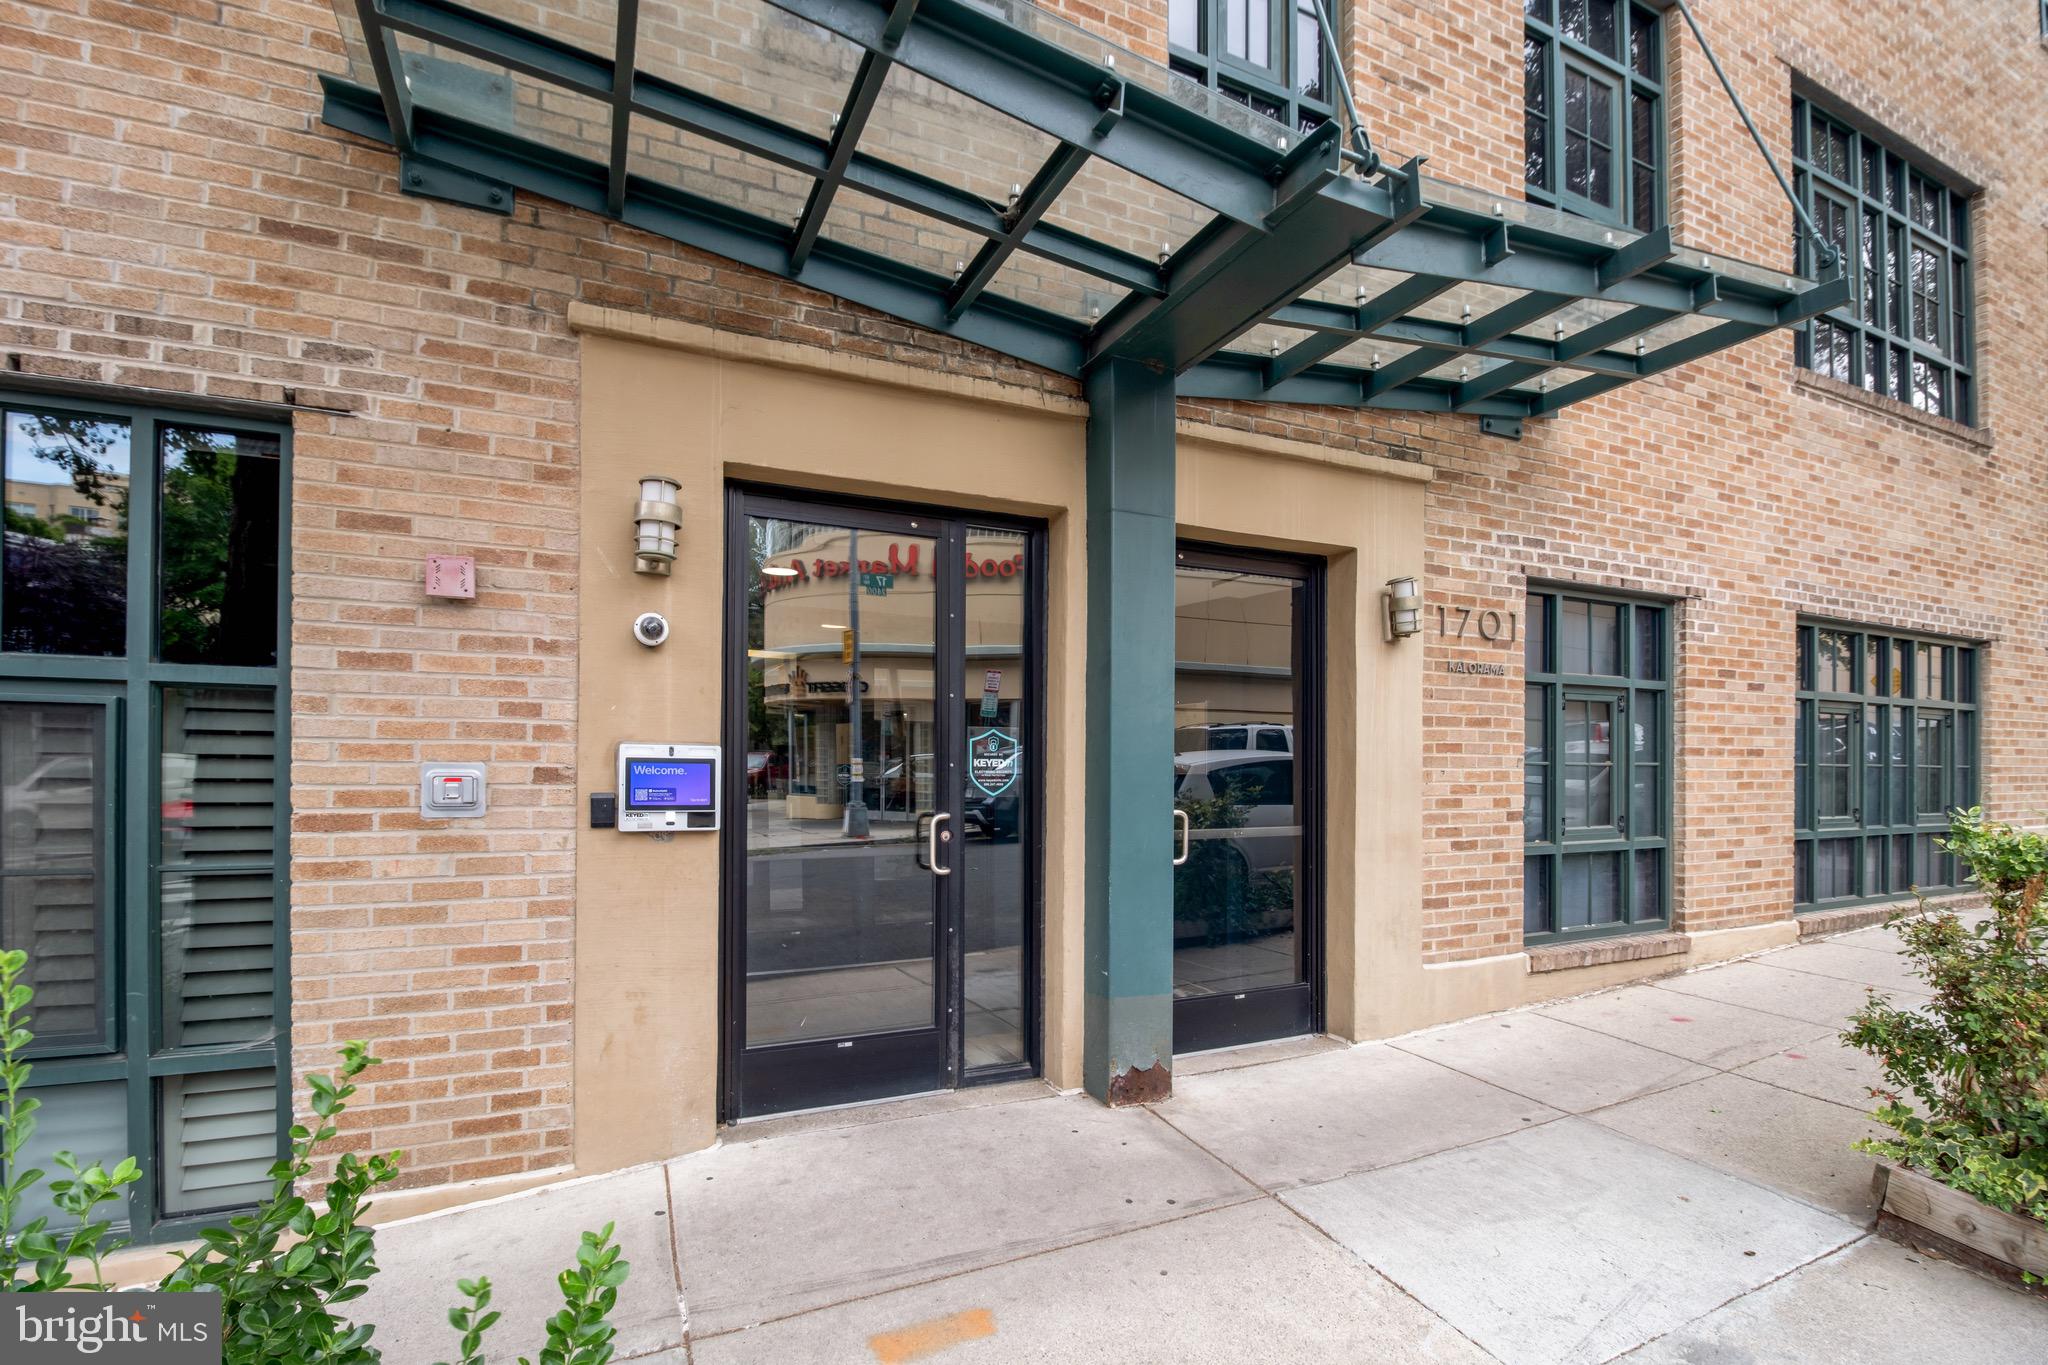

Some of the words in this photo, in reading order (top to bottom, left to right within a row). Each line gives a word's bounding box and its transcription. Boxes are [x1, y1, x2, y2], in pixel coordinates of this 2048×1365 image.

[1438, 605, 1517, 642] 1701
[1448, 661, 1505, 676] KALORAMA
[633, 765, 688, 775] Welcome.
